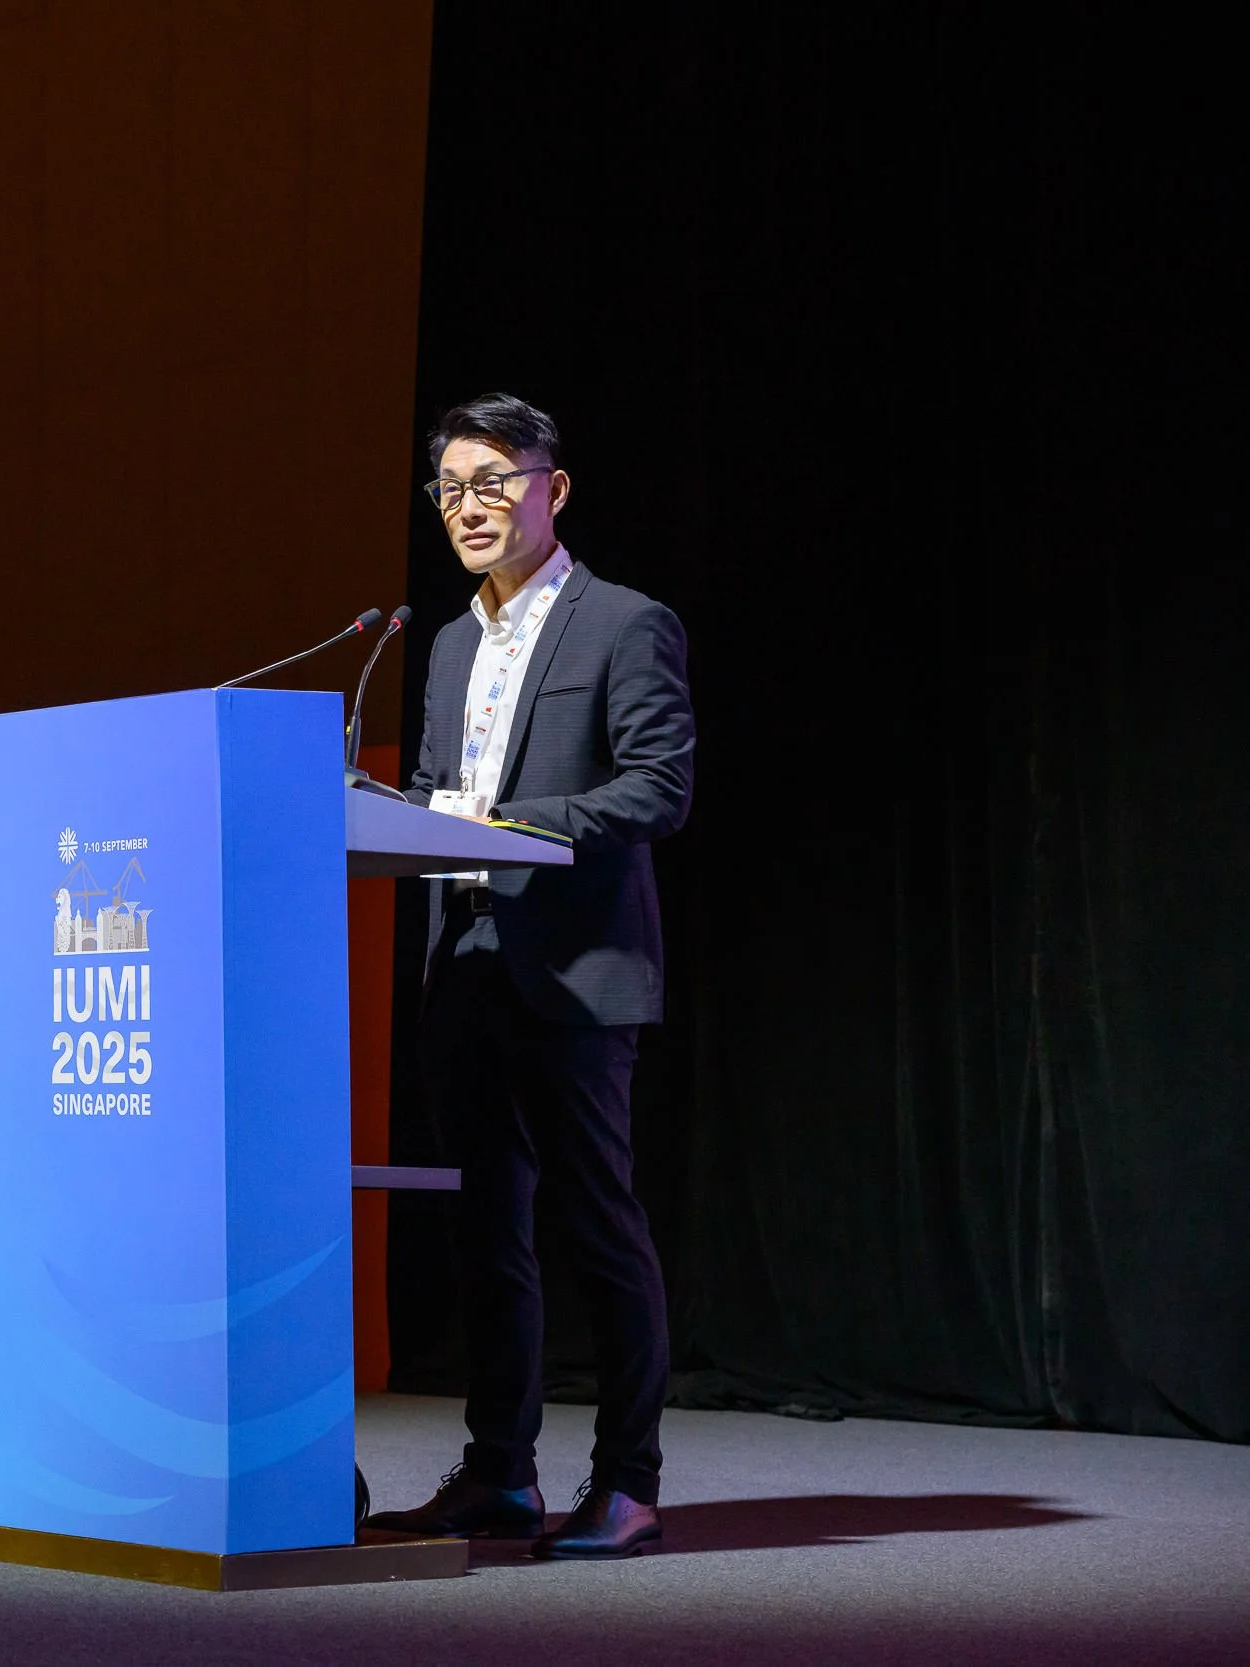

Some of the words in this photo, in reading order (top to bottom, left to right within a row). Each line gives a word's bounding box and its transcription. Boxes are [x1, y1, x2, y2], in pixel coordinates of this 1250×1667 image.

[83, 842, 100, 853] 7-10
[102, 838, 148, 852] SEPTEMBER
[53, 965, 151, 1023] IUMI
[52, 1031, 152, 1085] 2025
[53, 1093, 151, 1116] SINGAPORE
